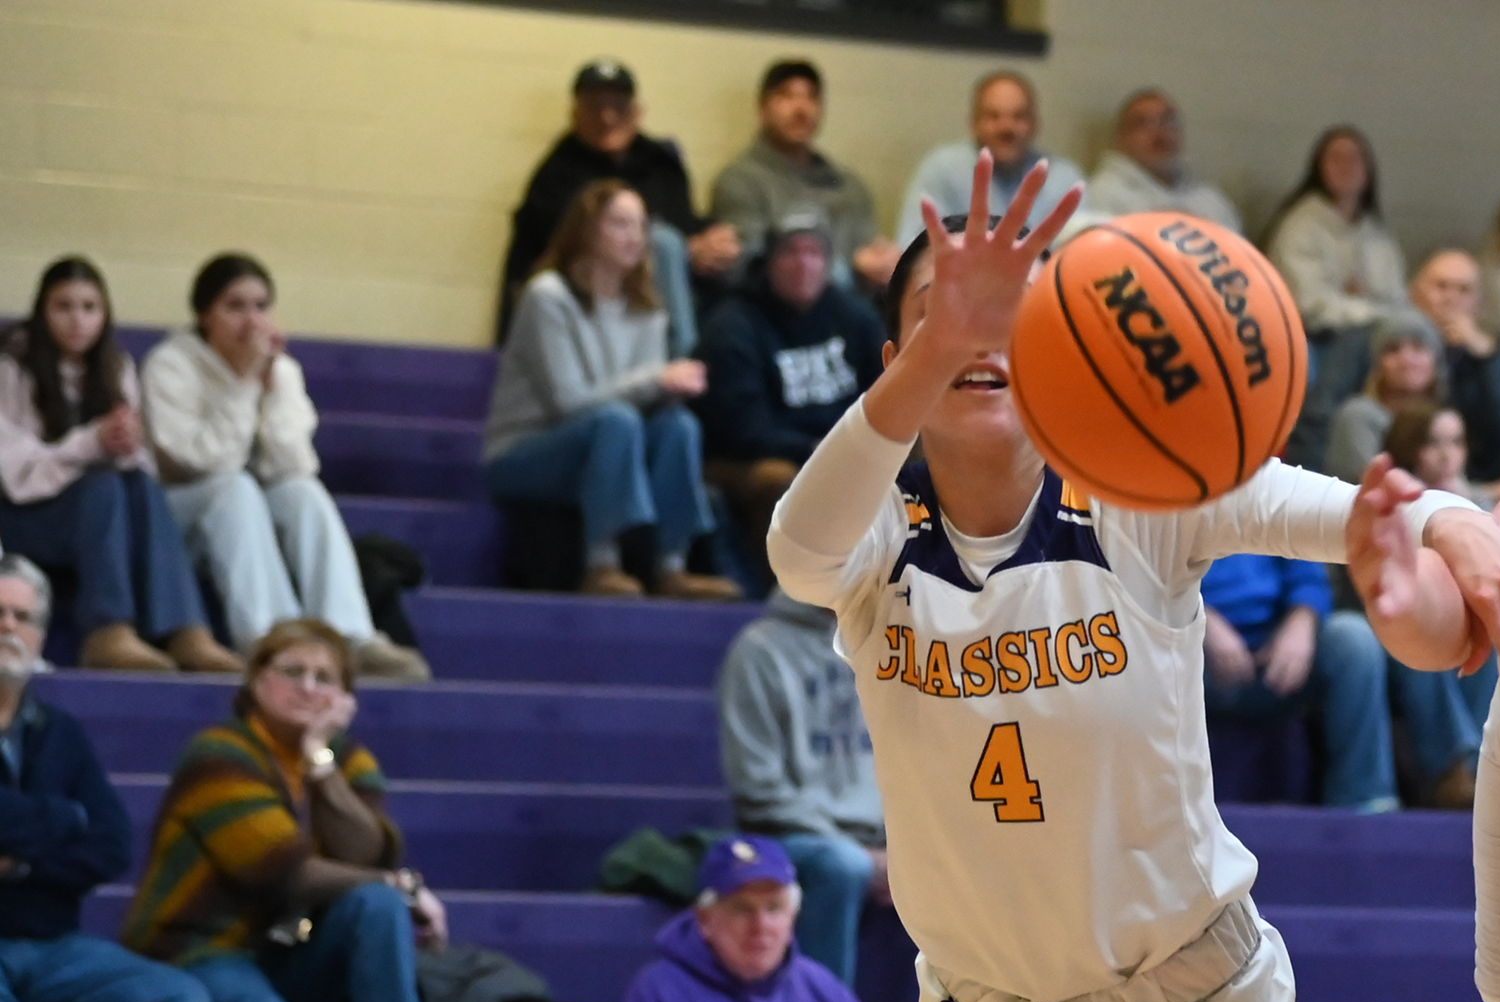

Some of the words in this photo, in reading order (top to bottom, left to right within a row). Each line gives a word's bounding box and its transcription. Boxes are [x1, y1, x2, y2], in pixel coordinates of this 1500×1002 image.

[1094, 266, 1201, 405] NCAA
[1159, 220, 1271, 388] Wilson
[877, 611, 1127, 698] CLASSICS
[970, 721, 1045, 823] 4
